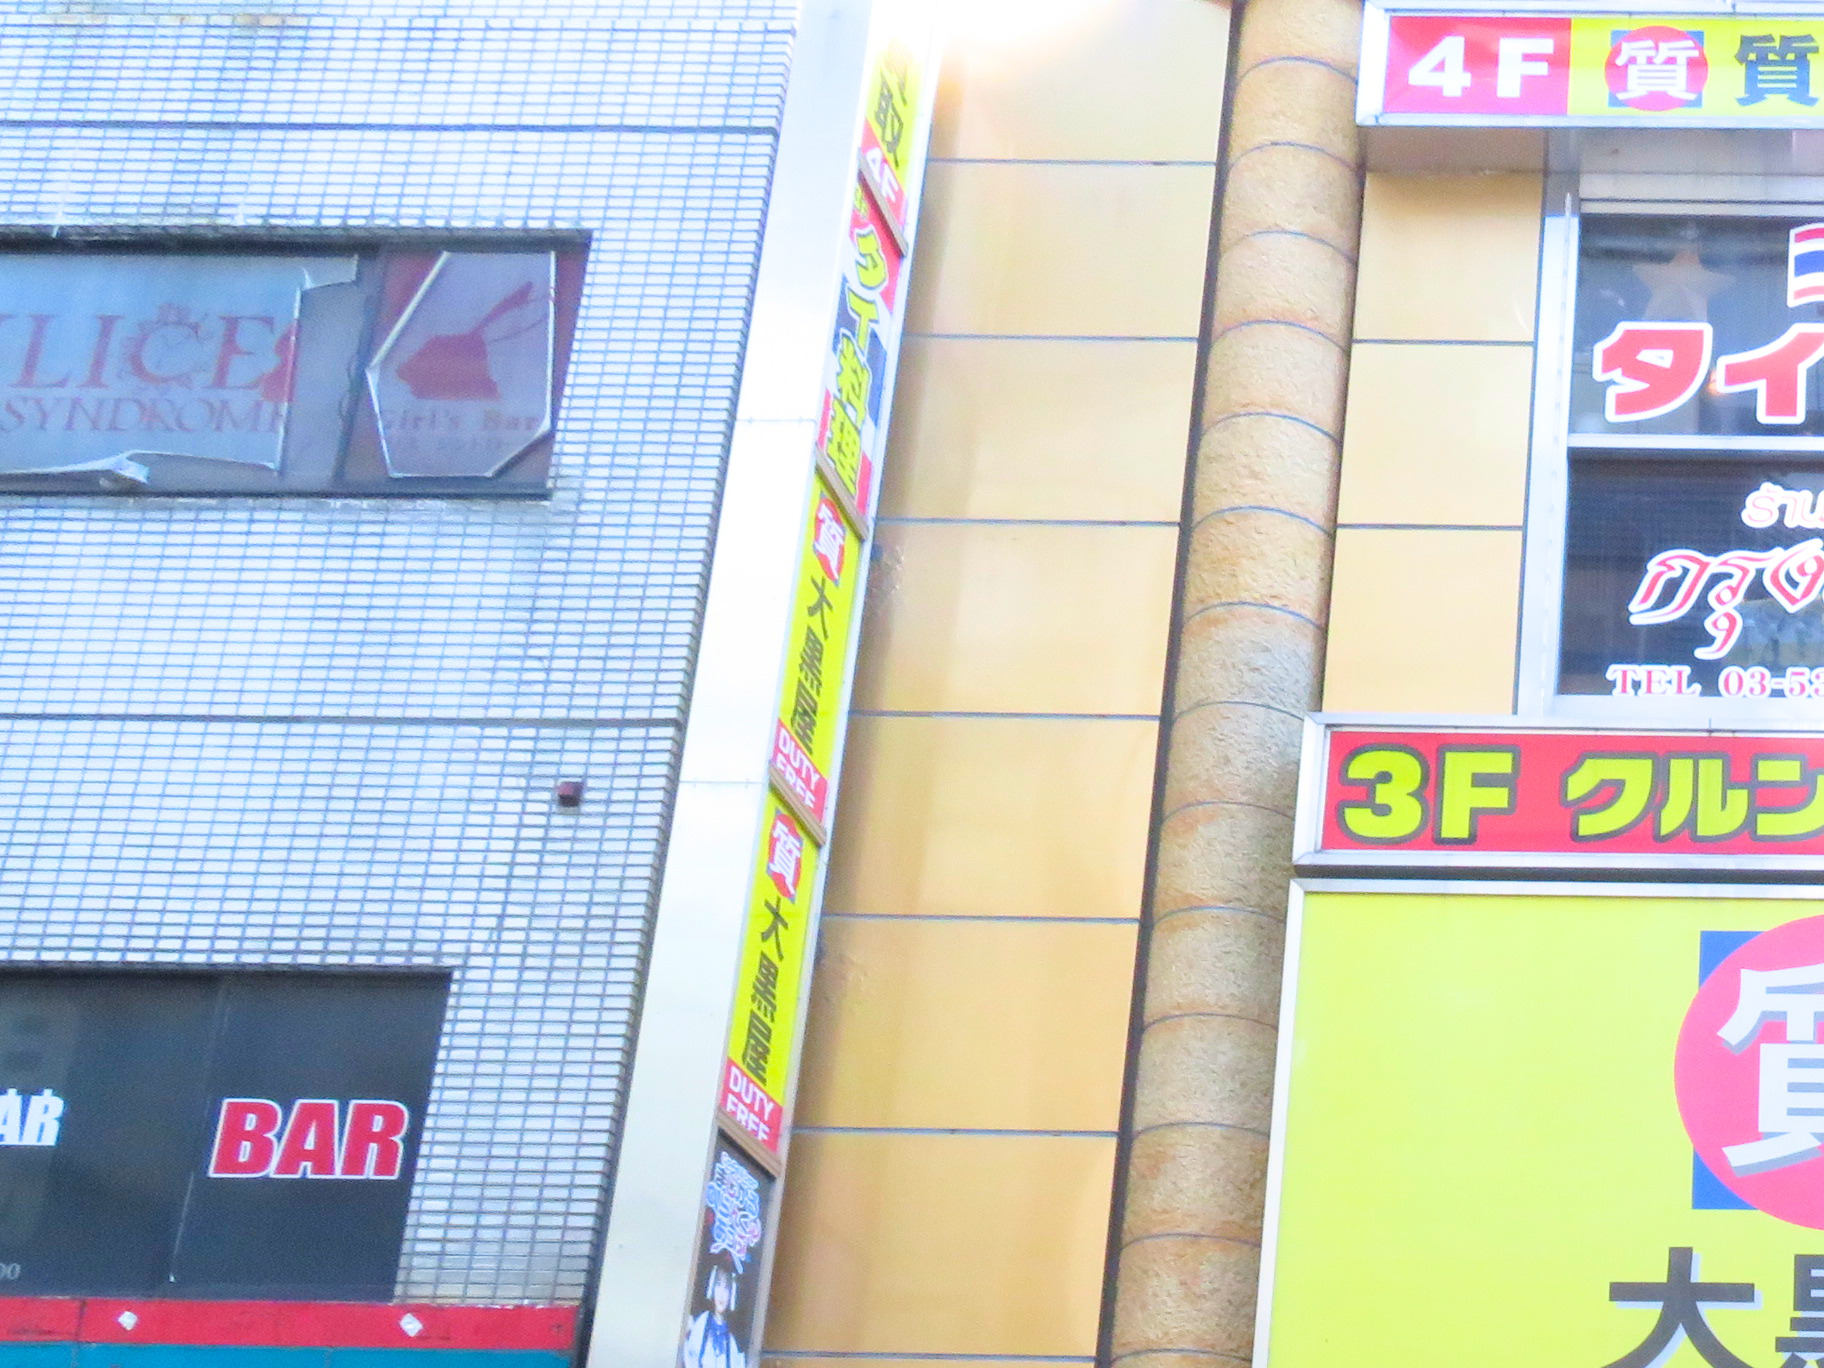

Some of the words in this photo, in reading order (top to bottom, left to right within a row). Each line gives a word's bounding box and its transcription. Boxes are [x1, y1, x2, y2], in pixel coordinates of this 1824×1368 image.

[1407, 34, 1556, 99] 4F
[1614, 40, 1702, 104] 質
[0, 312, 275, 392] LICE
[826, 228, 888, 497] タイ料理
[793, 574, 835, 759] 大黒屋
[1606, 665, 1700, 697] TEL
[776, 725, 821, 790] DUTY
[1336, 744, 1518, 846] 3F
[745, 894, 790, 1089] 大黒屋
[728, 1064, 776, 1122] DUTY
[207, 1097, 410, 1180] BAR
